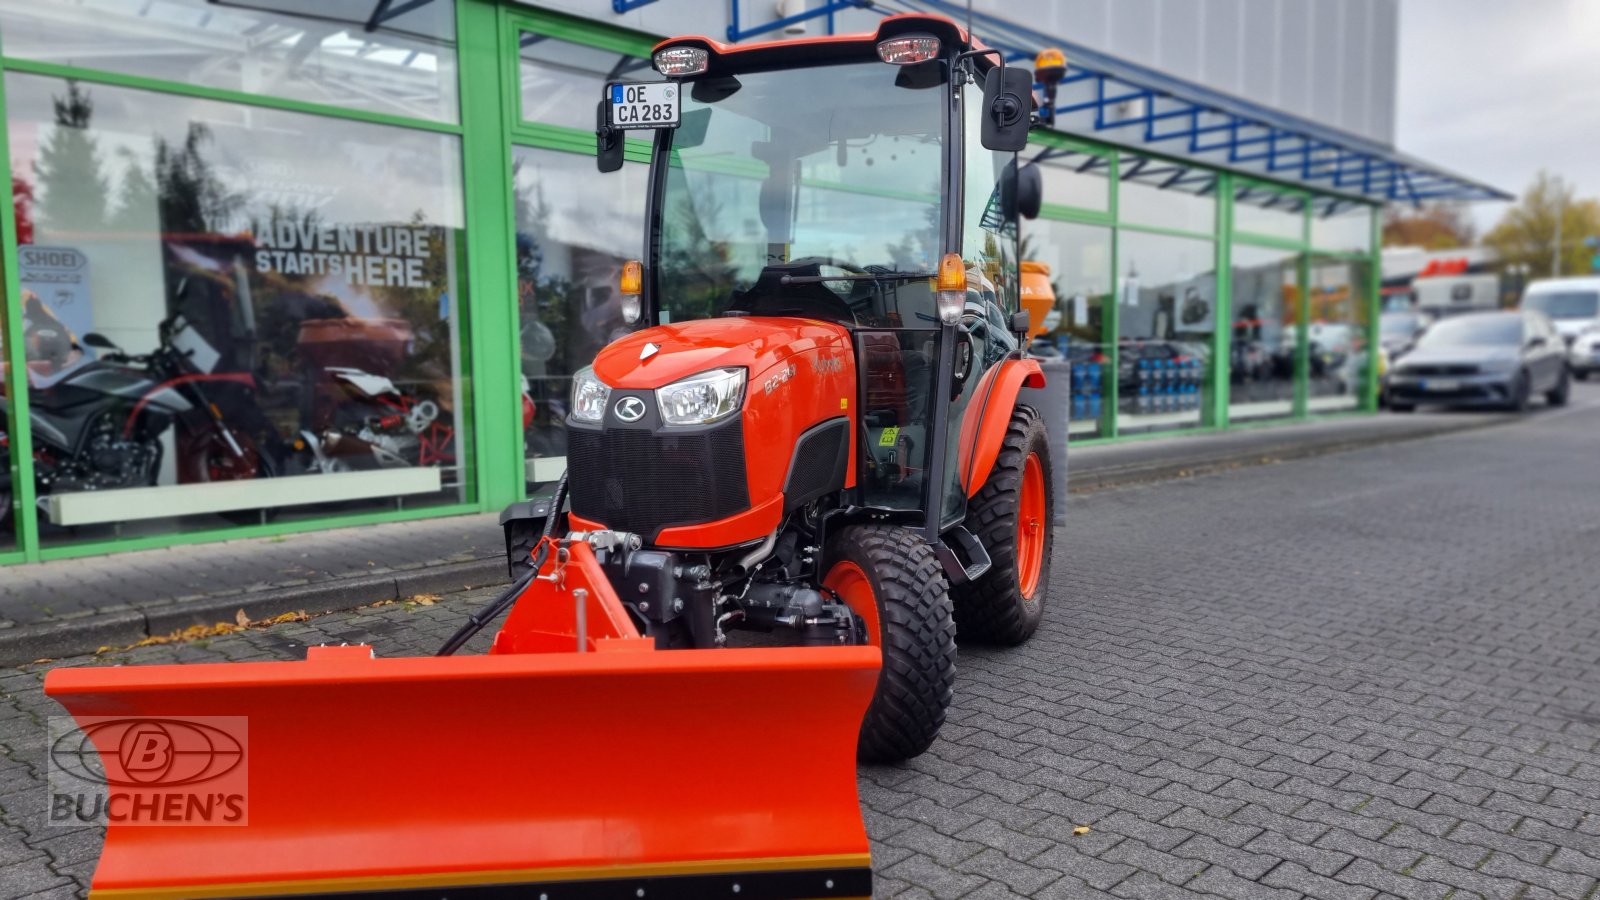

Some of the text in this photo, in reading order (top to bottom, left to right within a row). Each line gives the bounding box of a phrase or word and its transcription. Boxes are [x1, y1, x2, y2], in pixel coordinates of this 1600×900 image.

[626, 86, 647, 103] OE
[255, 216, 431, 258] ADVENTURE
[24, 252, 76, 267] SHOEI
[256, 250, 431, 288] STARTS HERE.
